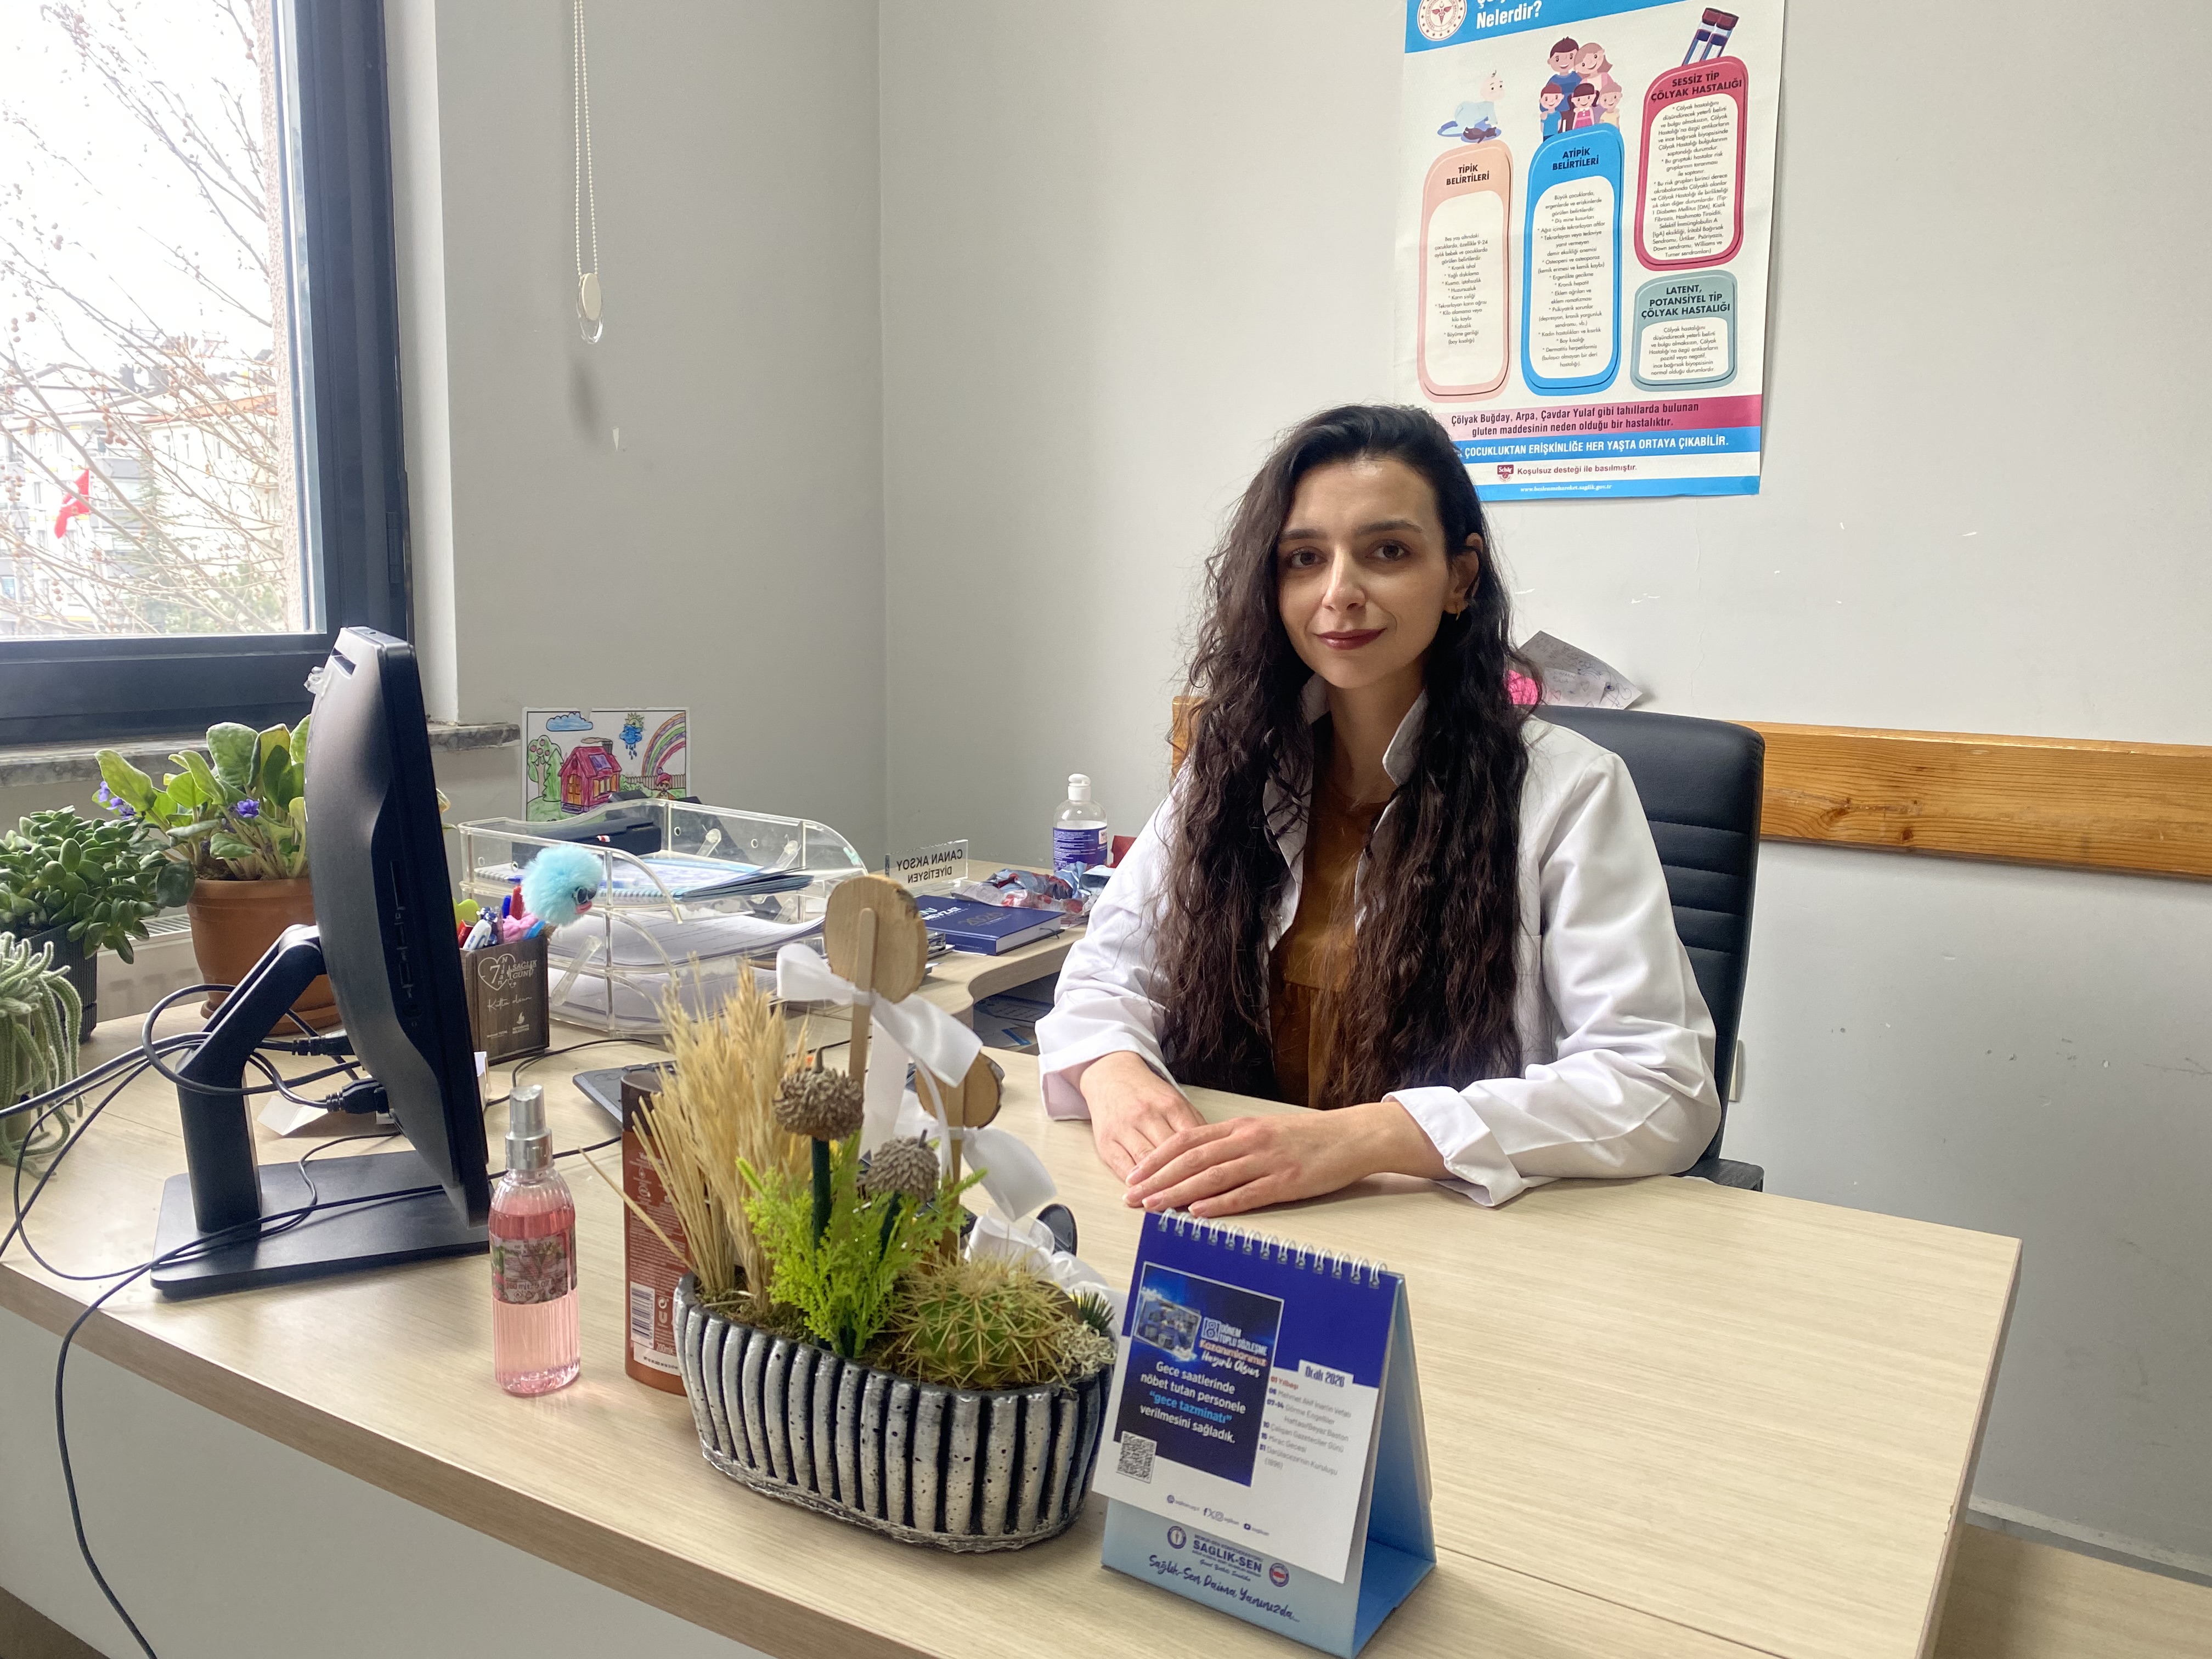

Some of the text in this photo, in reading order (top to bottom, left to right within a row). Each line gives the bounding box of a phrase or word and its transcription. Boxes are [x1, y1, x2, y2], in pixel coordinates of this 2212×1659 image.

[1476, 1, 1542, 29] Nelerdir?
[1672, 71, 1719, 87] SESSİZ TİP
[1651, 78, 1741, 102] ÇÖLYAK HASTALIĞI
[1553, 155, 1599, 170] BELİRTİLERİ
[1562, 146, 1590, 159] ATİPİK
[1447, 171, 1489, 185] BELİRTİLERİ
[1458, 163, 1478, 173] TİPİK
[1650, 291, 1722, 306] POTANSİYEL TİP
[1667, 285, 1702, 295] LATENT,
[1641, 302, 1730, 319] ÇÖLYAK HASTALIĞI
[1452, 403, 1699, 426] Çölyak Buğday, Arpa, Çavdar Yulaf gibi tahıllarda bulunan
[1472, 417, 1673, 437] gluten maddesinin neden olduğu bir hastalıktır.
[1465, 445, 1526, 459] ÇOCUKLUKTAN
[1529, 441, 1583, 455] ERİŞKİNLİĞE
[1586, 442, 1604, 451] HER
[1607, 440, 1636, 452] YAŞTA
[1639, 438, 1675, 449] ORTAYA
[1679, 435, 1728, 449] ÇIKABİLİR.
[1517, 467, 1551, 476] Koşulsuz
[1554, 466, 1581, 474] desteği
[489, 964, 500, 984] 7
[1156, 1362, 1234, 1393] Gece saatlerinde
[1305, 1366, 1345, 1388] Ocak 2026
[1141, 1374, 1245, 1413] nöbet tutan personele
[1141, 1406, 1234, 1443] verilmesini sağladık.
